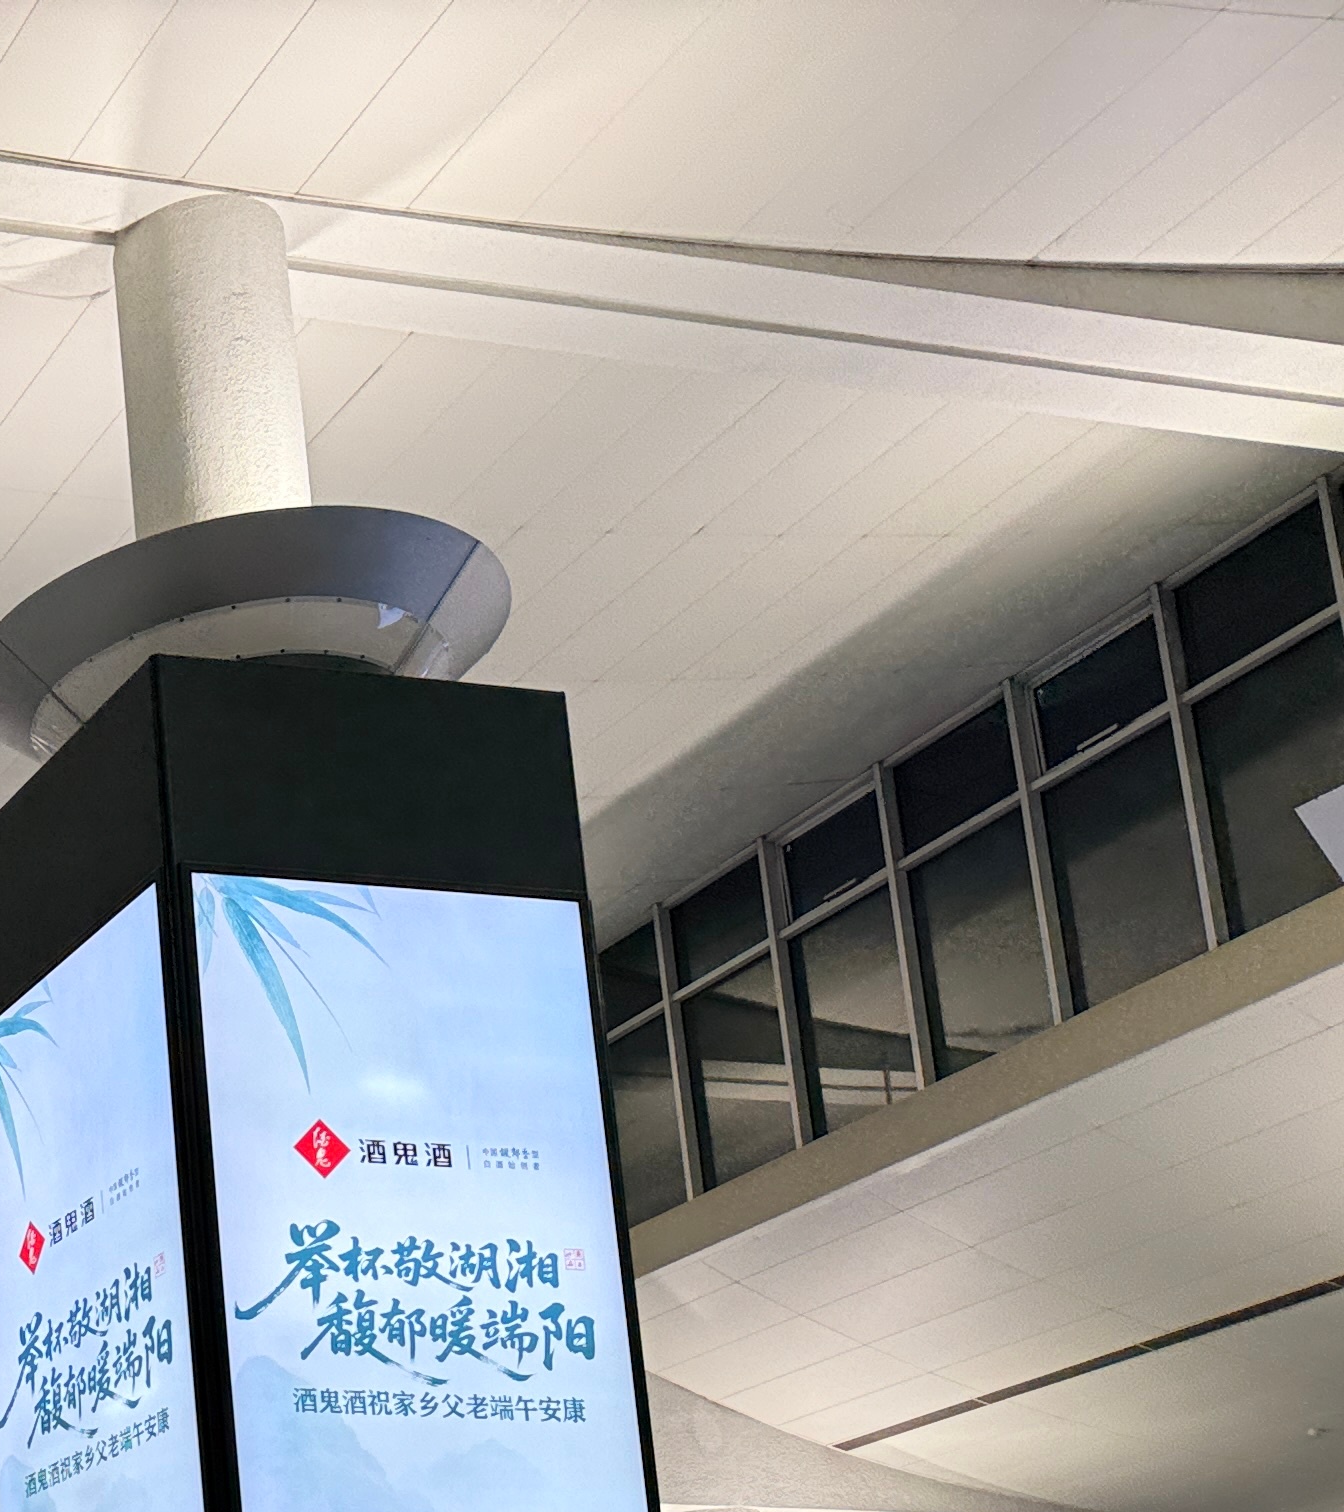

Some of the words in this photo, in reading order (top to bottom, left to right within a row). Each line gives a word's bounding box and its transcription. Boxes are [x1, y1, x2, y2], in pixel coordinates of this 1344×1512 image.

[358, 1138, 453, 1169] 酒鬼酒
[48, 1196, 95, 1247] 酒鬼酒
[234, 1218, 559, 1320] 举杯敬湖湘
[301, 1292, 596, 1385] 馥郁暖端阳
[292, 1386, 587, 1425] 酒鬼酒祝家乡父老端午安康
[23, 1407, 170, 1498] 酒鬼酒祝家乡父老端午安康
